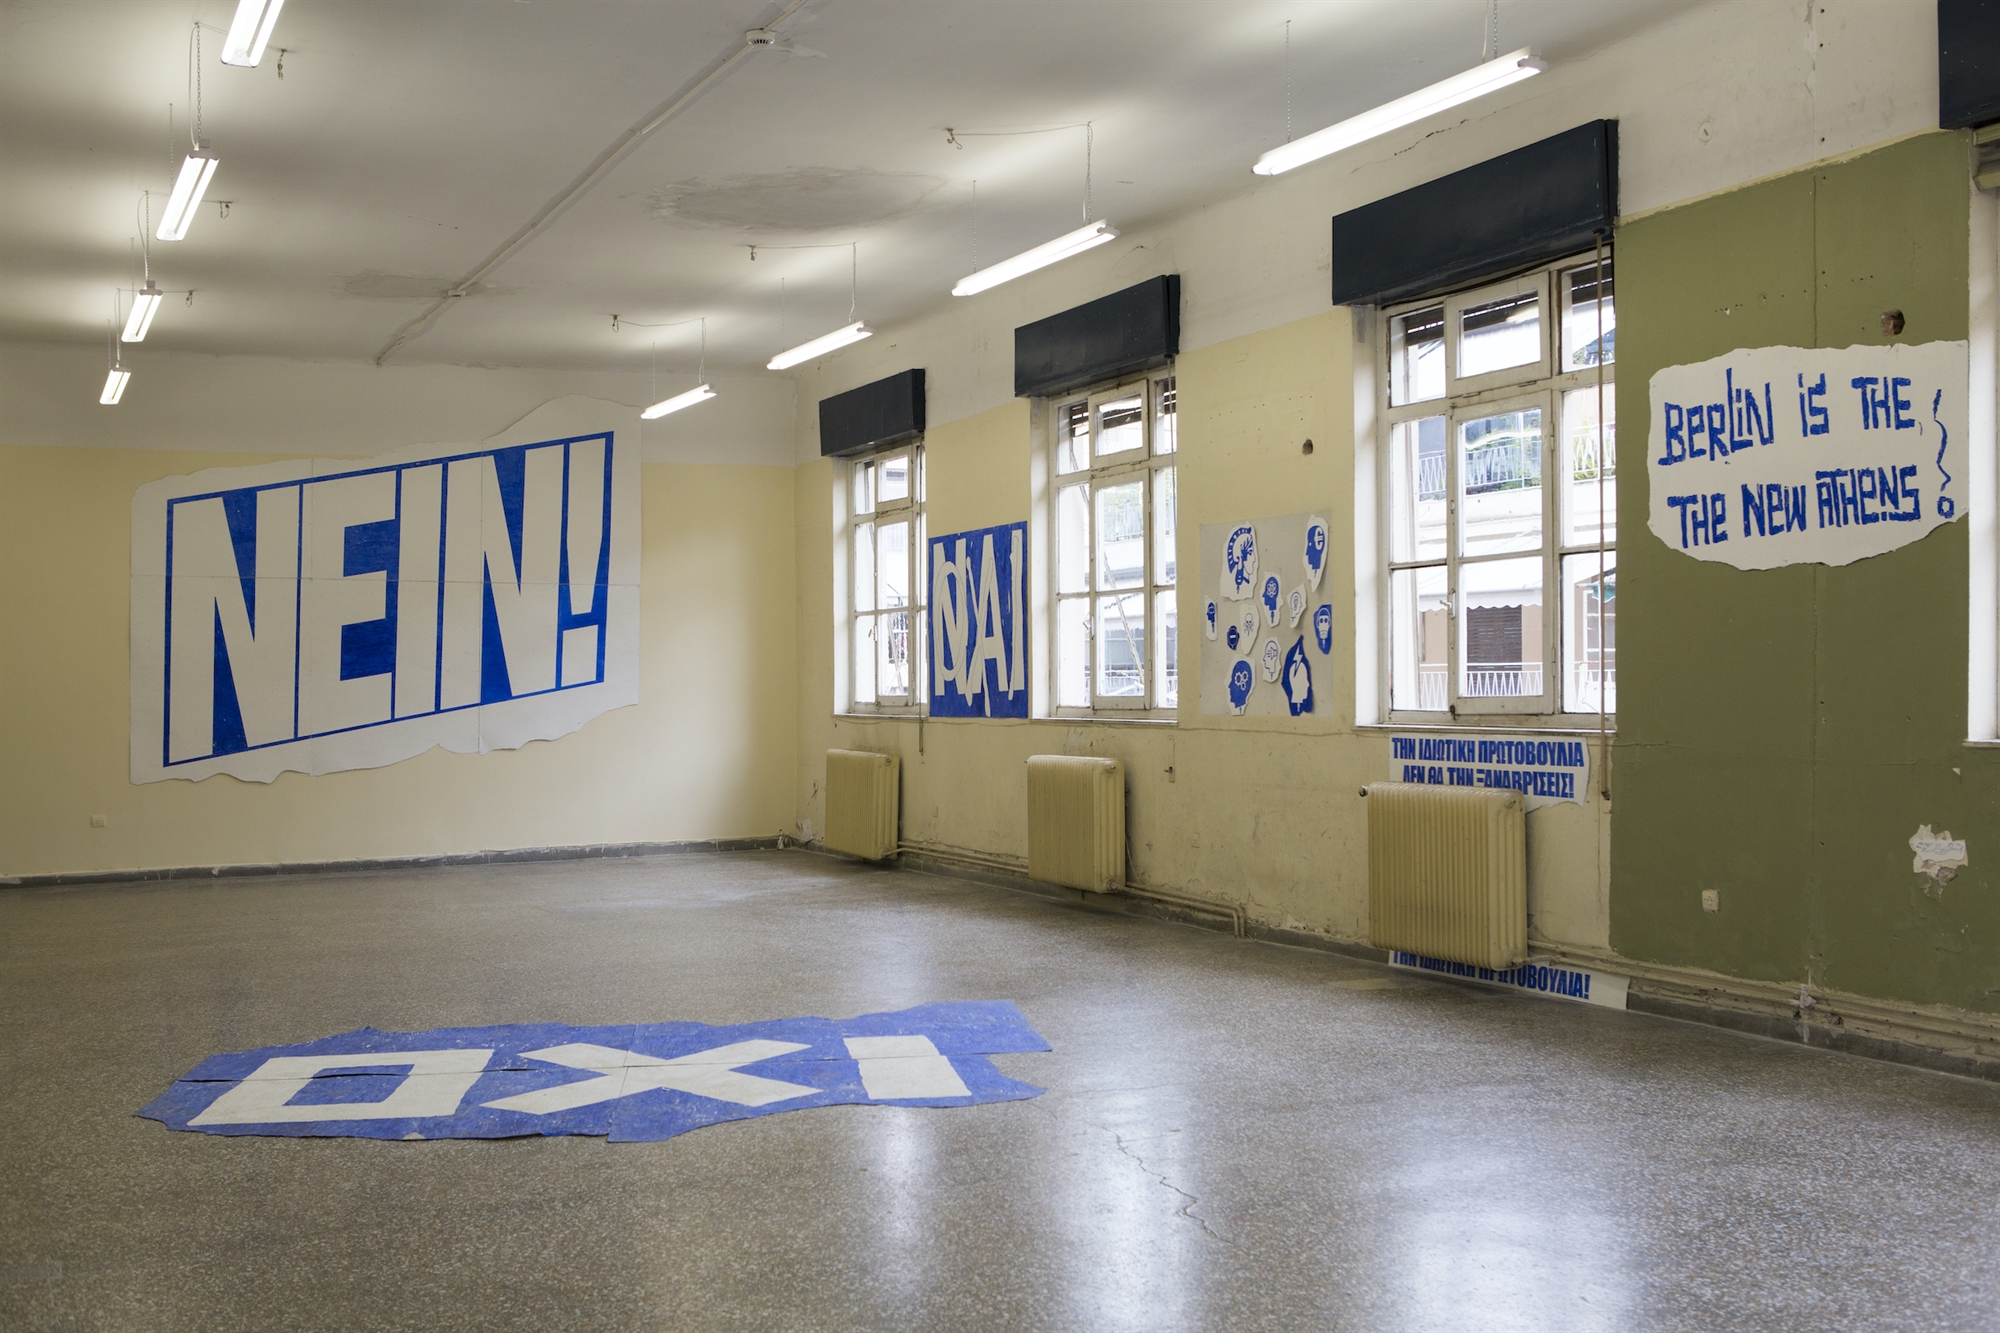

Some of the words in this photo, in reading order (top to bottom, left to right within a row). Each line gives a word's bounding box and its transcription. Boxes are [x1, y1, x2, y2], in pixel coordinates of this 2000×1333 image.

[168, 437, 607, 764] NEIN!
[1391, 737, 1416, 760] ΤΗΝ
[1419, 738, 1475, 763] ΙΔΙΩΤΙΚΗ
[1478, 740, 1585, 767] ΠΡΩΤΟΒΟΥΛΙΑ
[1447, 767, 1475, 788] ΤΗΝ
